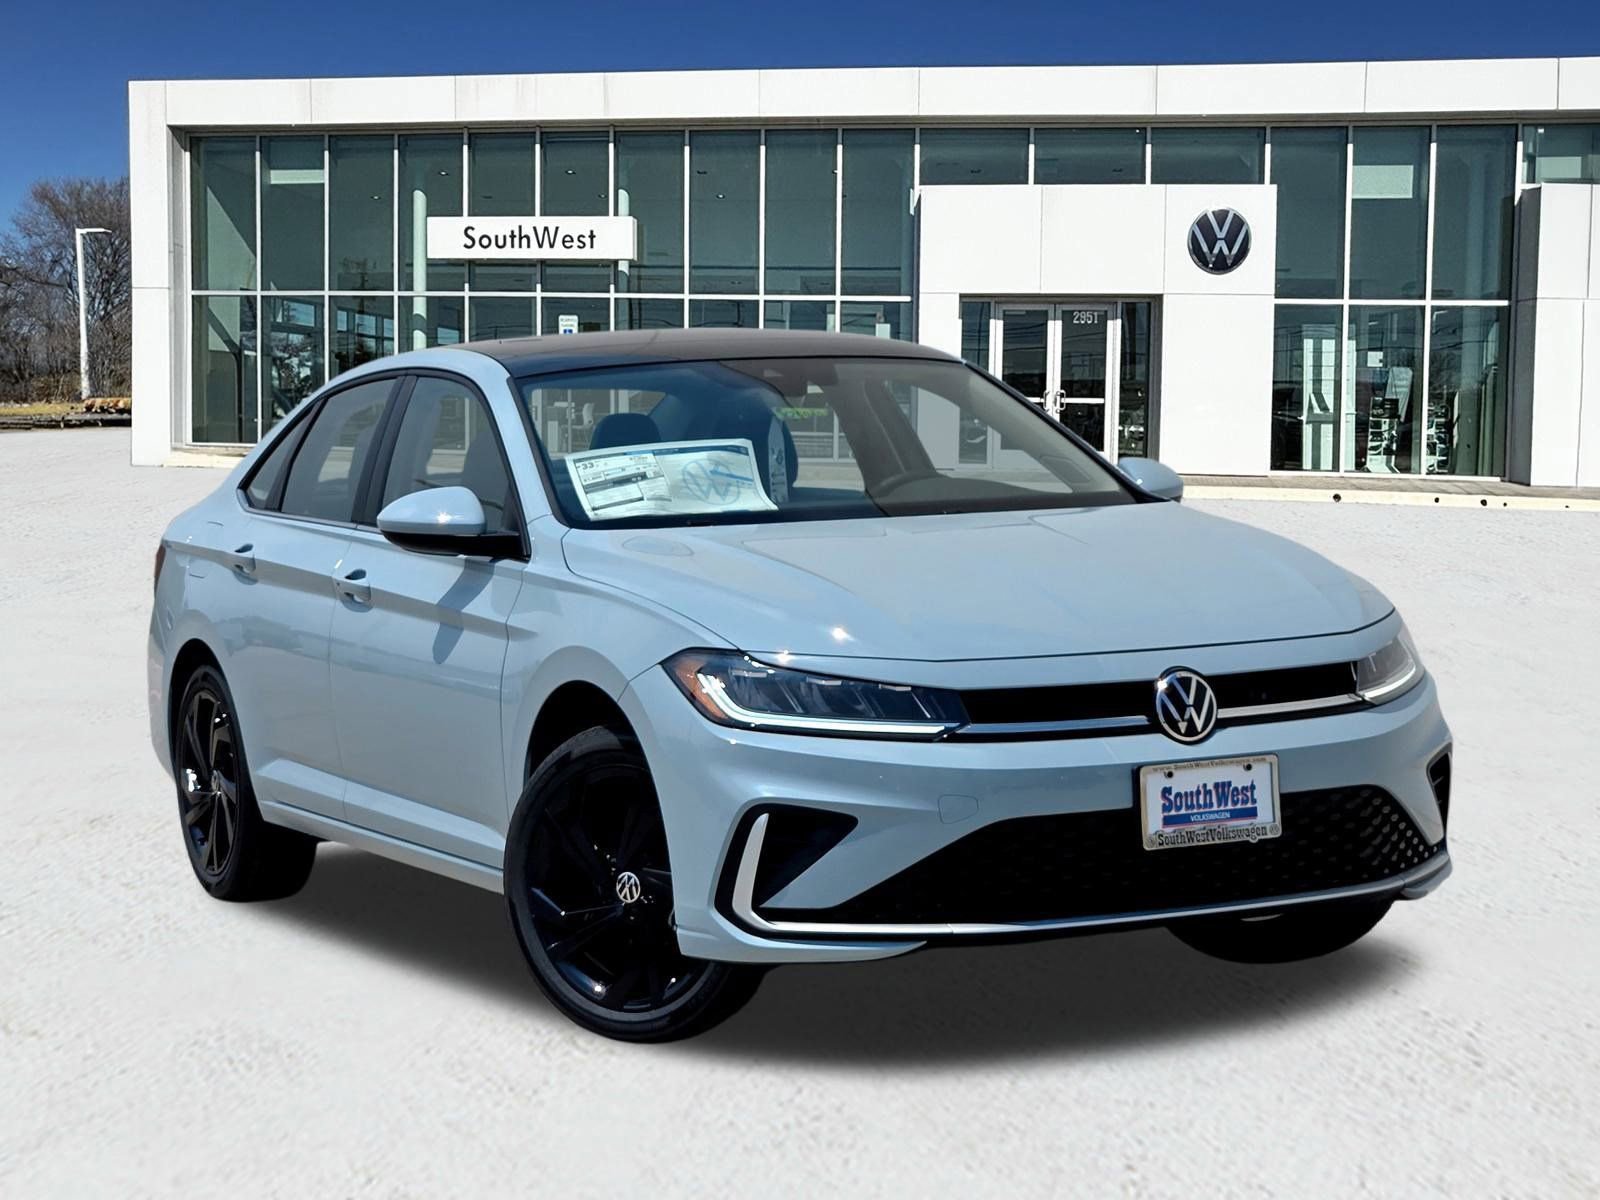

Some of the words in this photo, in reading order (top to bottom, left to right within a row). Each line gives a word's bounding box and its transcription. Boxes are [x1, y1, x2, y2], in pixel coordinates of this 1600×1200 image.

[463, 225, 596, 249] SouthWest
[1161, 779, 1257, 814] SouthWest
[1190, 811, 1231, 822] VOLKSWAGEN
[1158, 825, 1267, 846] SouthWestVolkswagen
